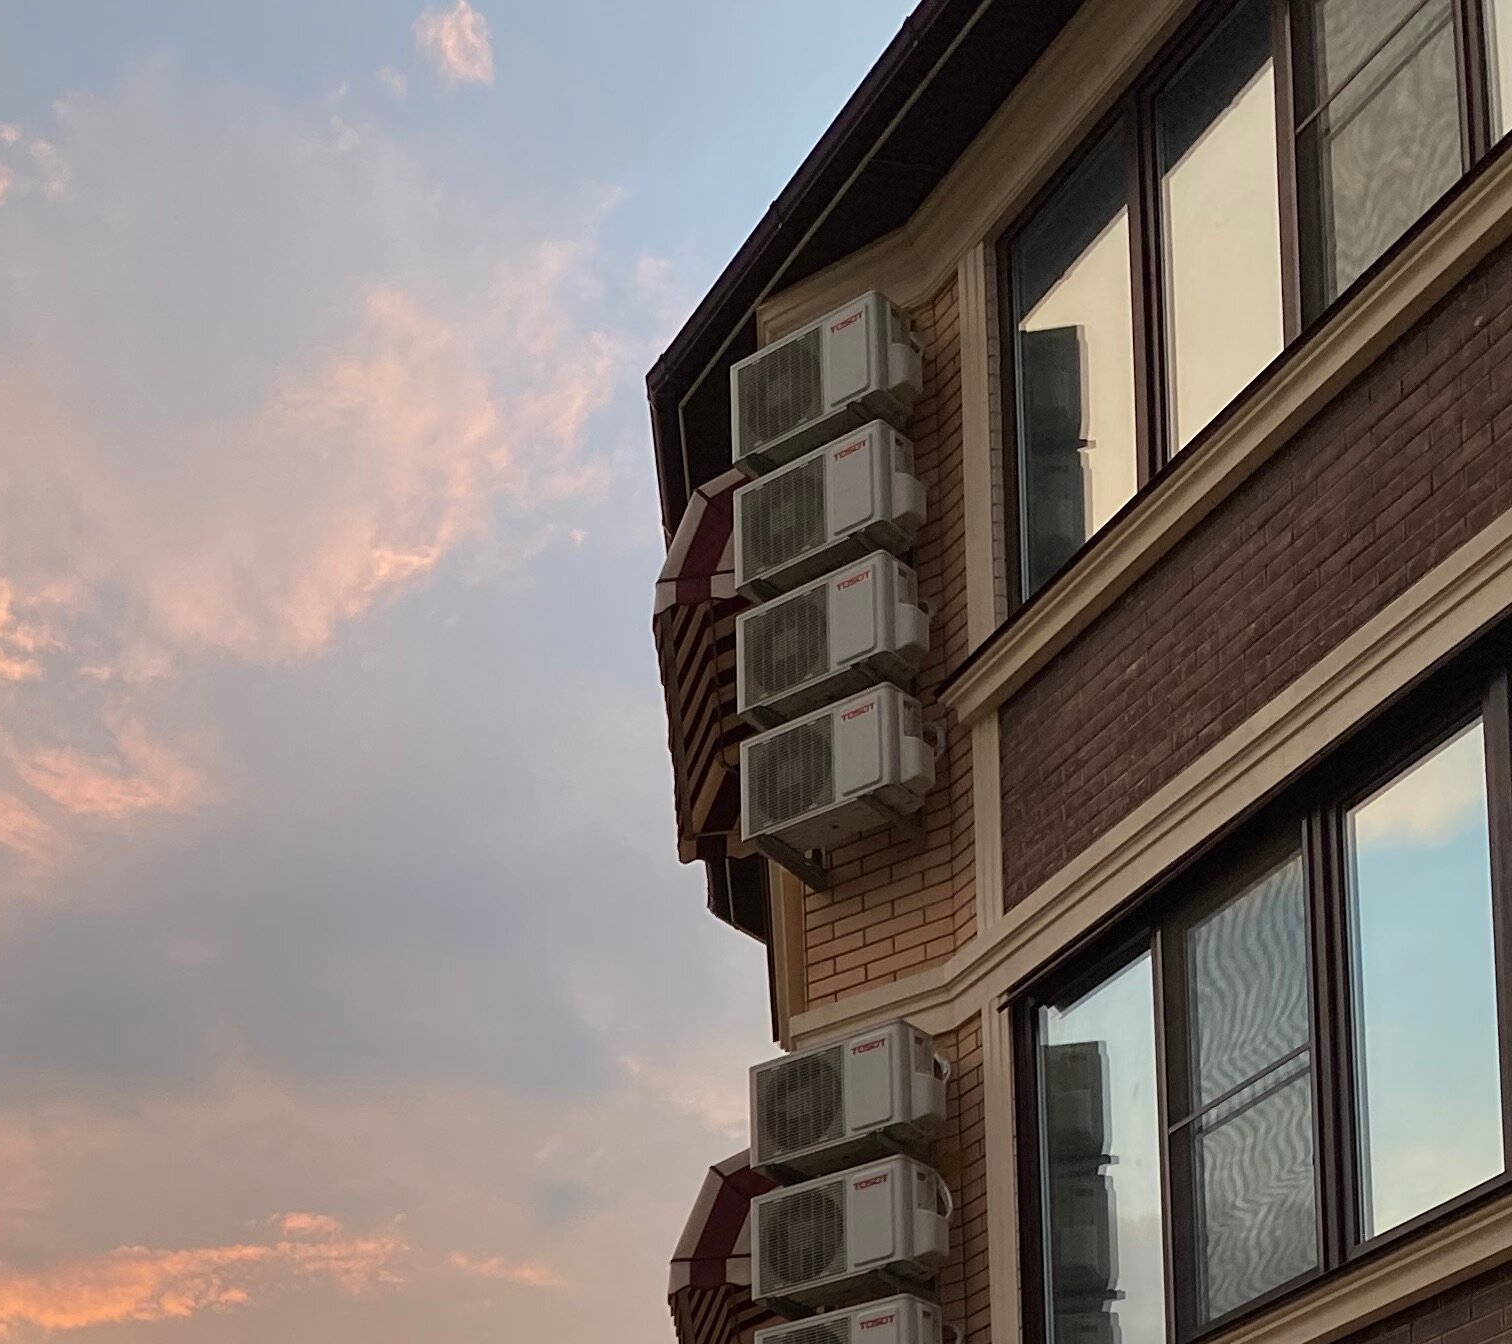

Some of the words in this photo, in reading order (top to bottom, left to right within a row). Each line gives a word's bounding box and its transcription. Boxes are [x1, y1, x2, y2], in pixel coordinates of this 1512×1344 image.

[830, 312, 863, 333] TOSOT
[834, 440, 867, 460] TOSOT
[837, 571, 870, 591] TOSOT
[841, 703, 875, 721] TOSOT
[851, 1039, 886, 1055] TOSOT
[853, 1175, 888, 1190] TOSOT
[860, 1315, 895, 1330] TOSOT
